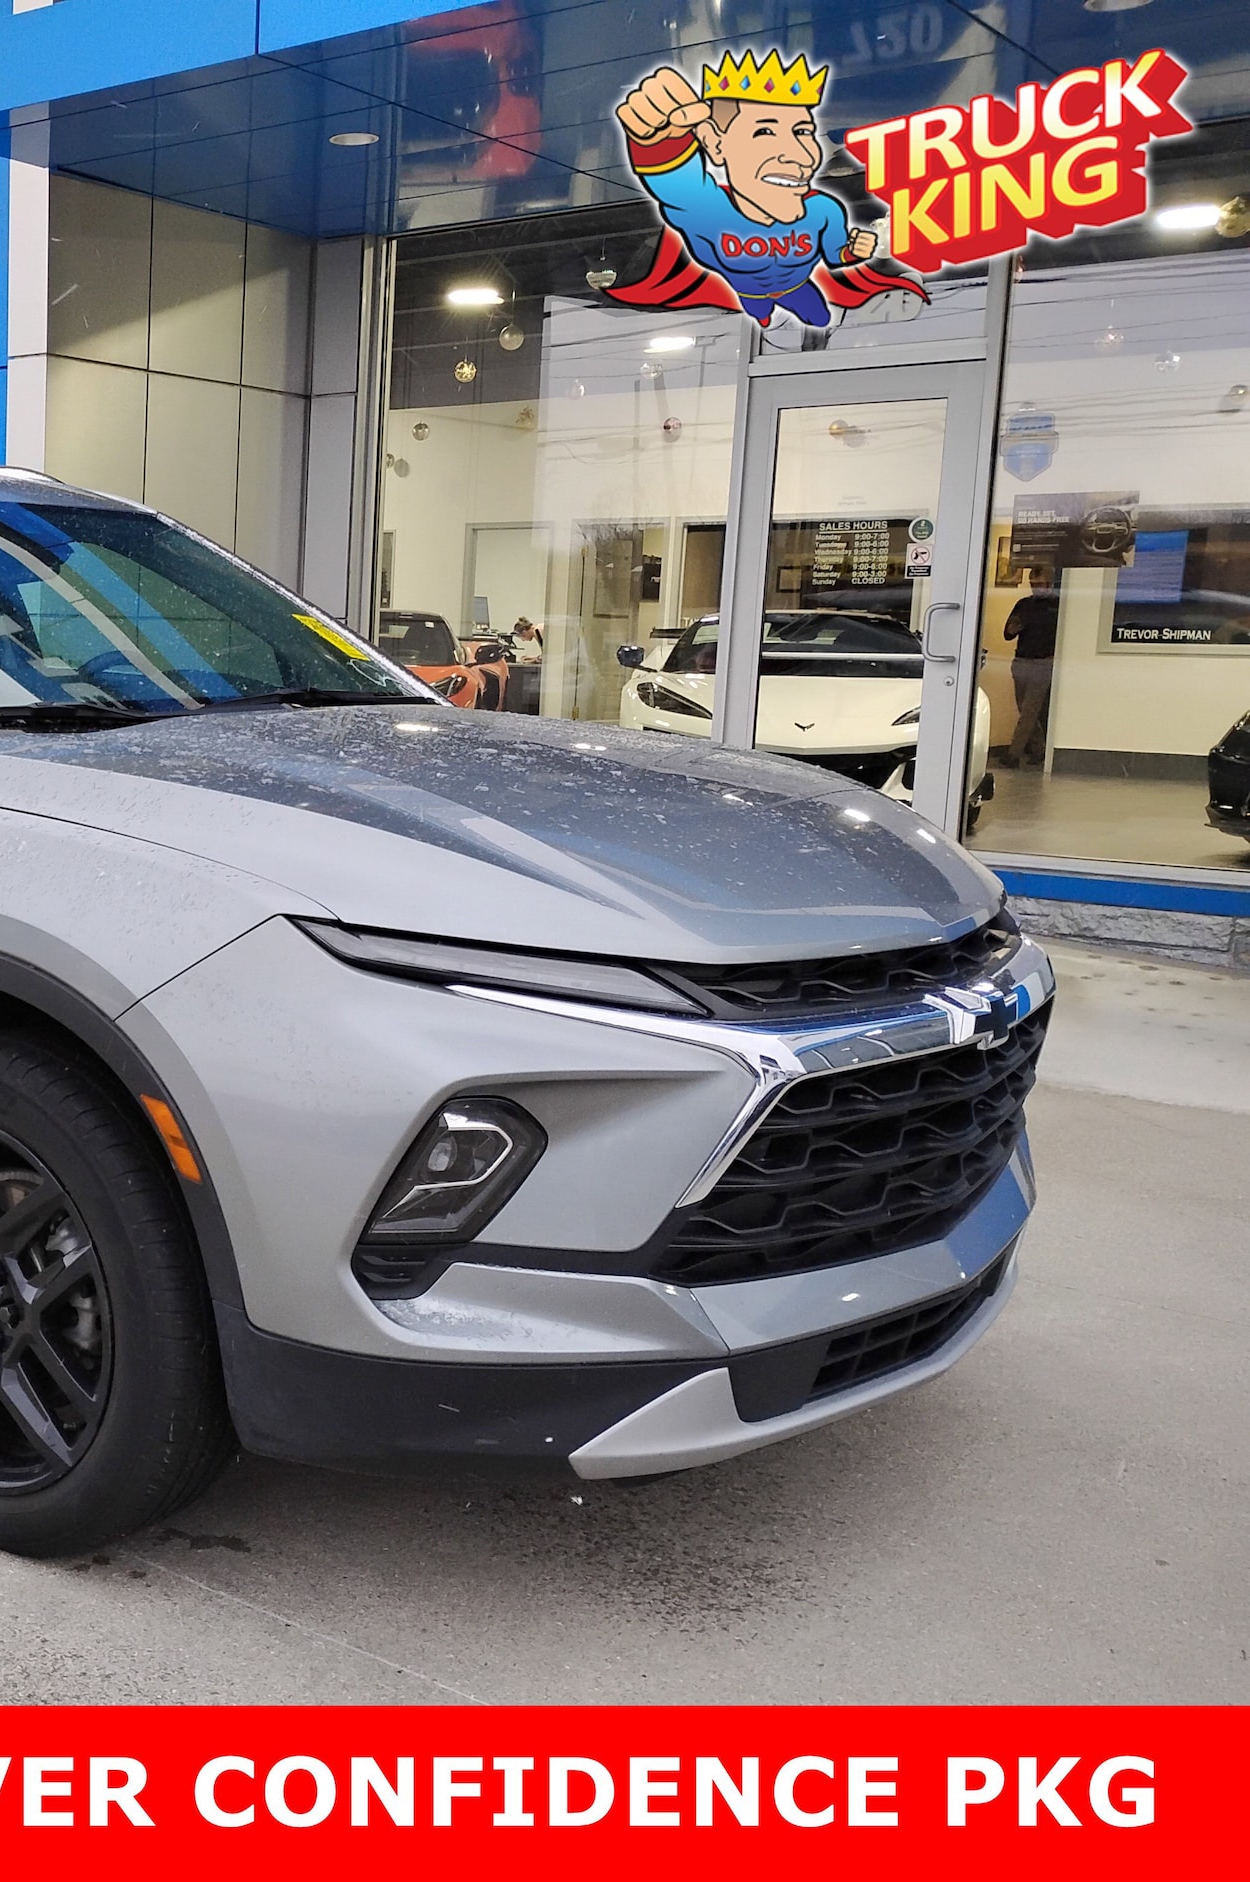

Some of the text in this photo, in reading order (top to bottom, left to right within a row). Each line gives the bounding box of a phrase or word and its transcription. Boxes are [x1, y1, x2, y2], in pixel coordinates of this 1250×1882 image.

[819, 521, 888, 531] SALES HOURS
[854, 532, 890, 540] 9:00-7:00
[1116, 628, 1211, 640] TREVOR SHIPMAN
